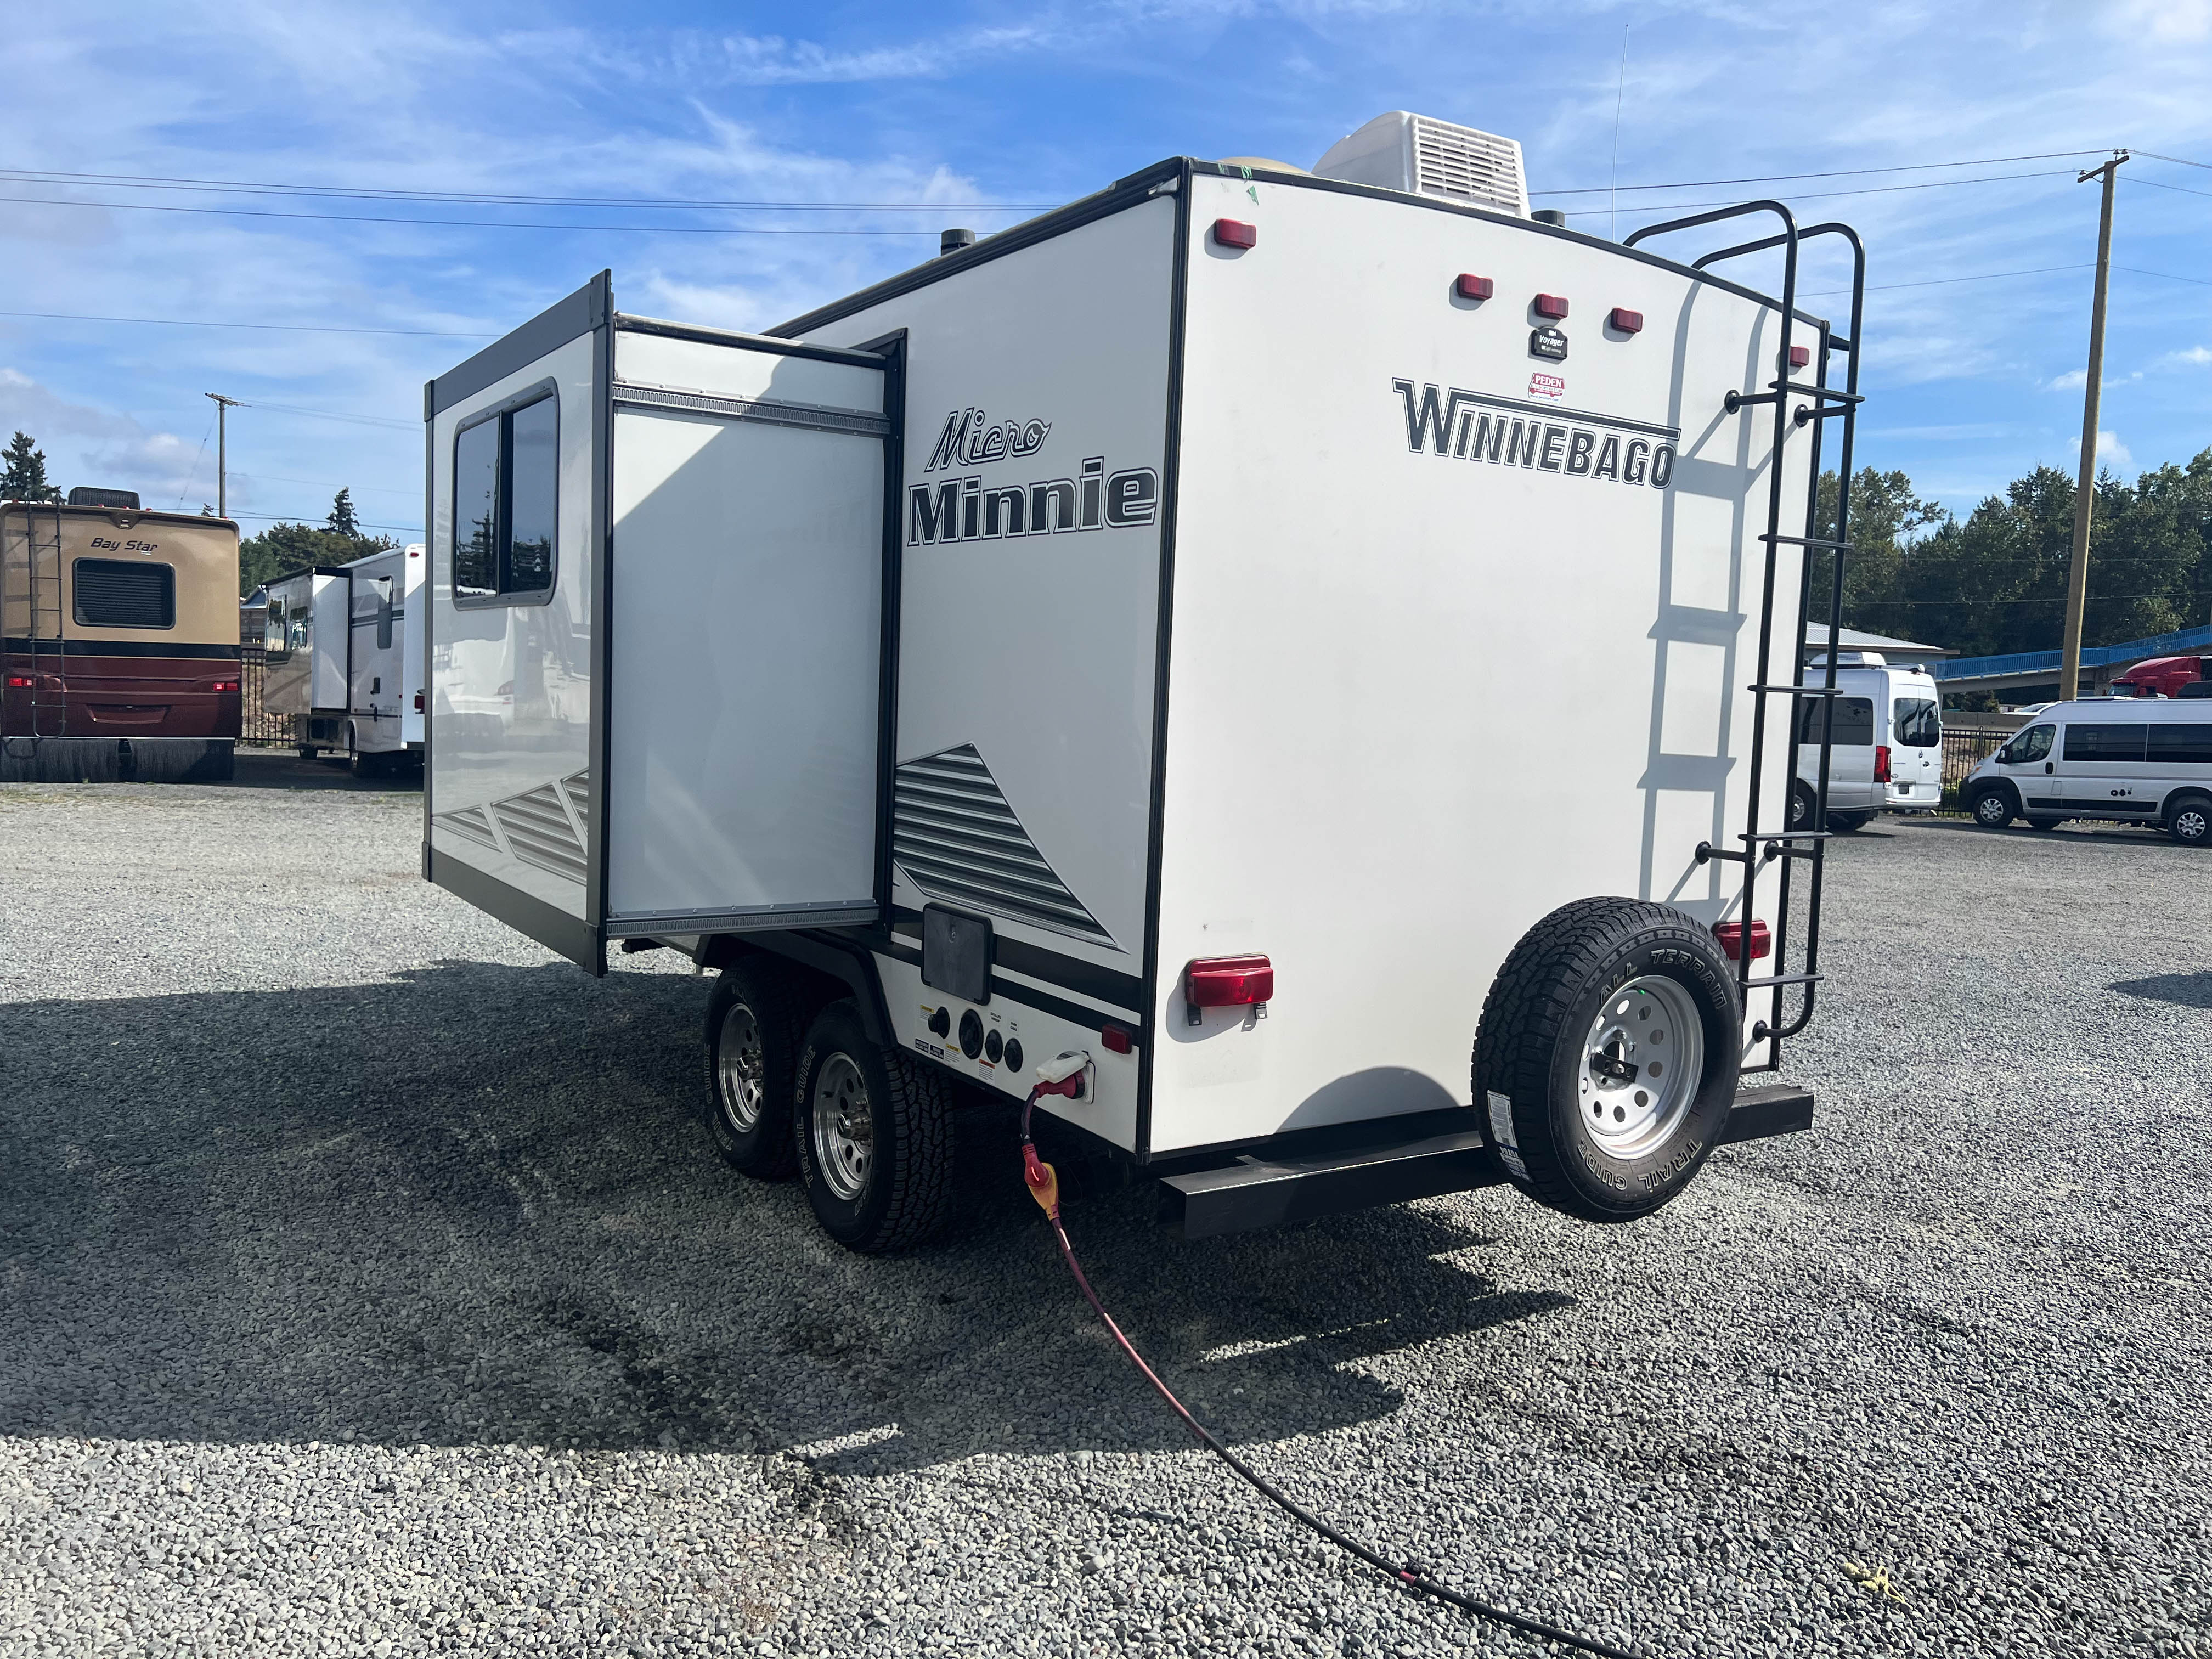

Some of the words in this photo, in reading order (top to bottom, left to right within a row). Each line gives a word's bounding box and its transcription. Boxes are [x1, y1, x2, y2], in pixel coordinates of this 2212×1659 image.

[1539, 335, 1564, 347] Voyager
[1536, 375, 1562, 388] PEDEN
[924, 407, 1052, 472] Micro
[1392, 377, 1681, 489] WINNEBAGO
[907, 456, 1159, 547] Minnie
[91, 538, 121, 551] Bay
[124, 540, 157, 551] Star
[1599, 961, 1638, 1006] ALL
[1651, 949, 1728, 1010] TERRAIN
[797, 1045, 816, 1103] GUIDE
[797, 1116, 814, 1189] TRAIL
[1577, 1137, 1628, 1190] GUIDE
[1637, 1138, 1703, 1190] TRAIL
